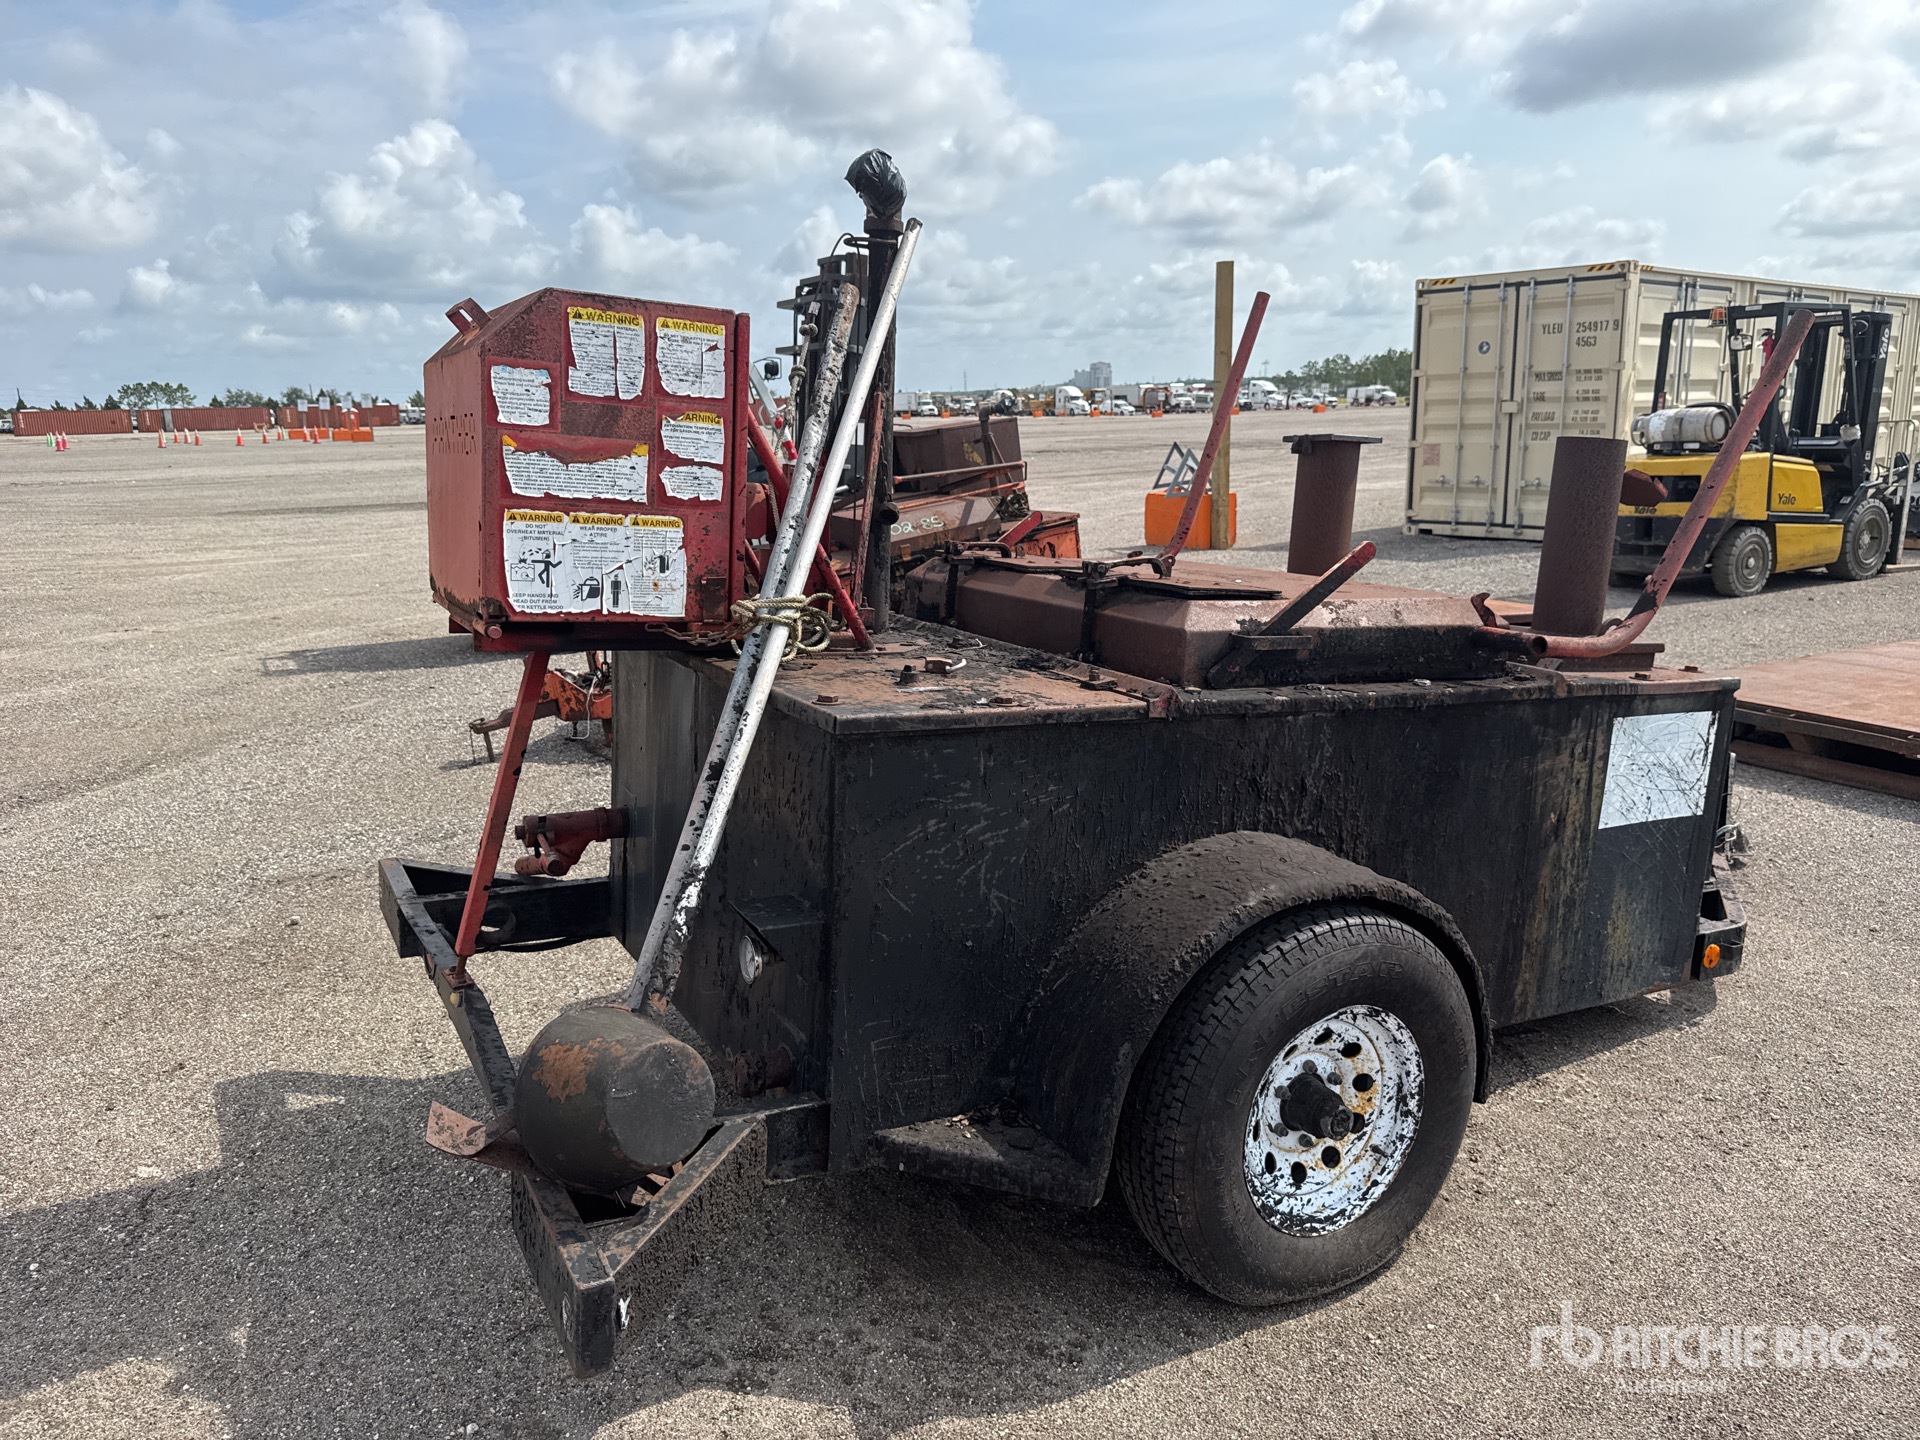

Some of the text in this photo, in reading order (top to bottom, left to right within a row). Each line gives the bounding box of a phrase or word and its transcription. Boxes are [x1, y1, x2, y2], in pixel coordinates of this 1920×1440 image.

[586, 311, 640, 326] WARNING
[673, 321, 719, 335] WARNING
[1542, 319, 1620, 335] YLEU 254917 9
[1575, 336, 1597, 348] 45G3
[1879, 328, 1890, 359] Yale
[683, 412, 720, 425] ARNING
[1778, 493, 1797, 505] Yale
[519, 513, 563, 523] WARNING
[582, 516, 623, 526] WARNING
[642, 519, 680, 528] WARNING
